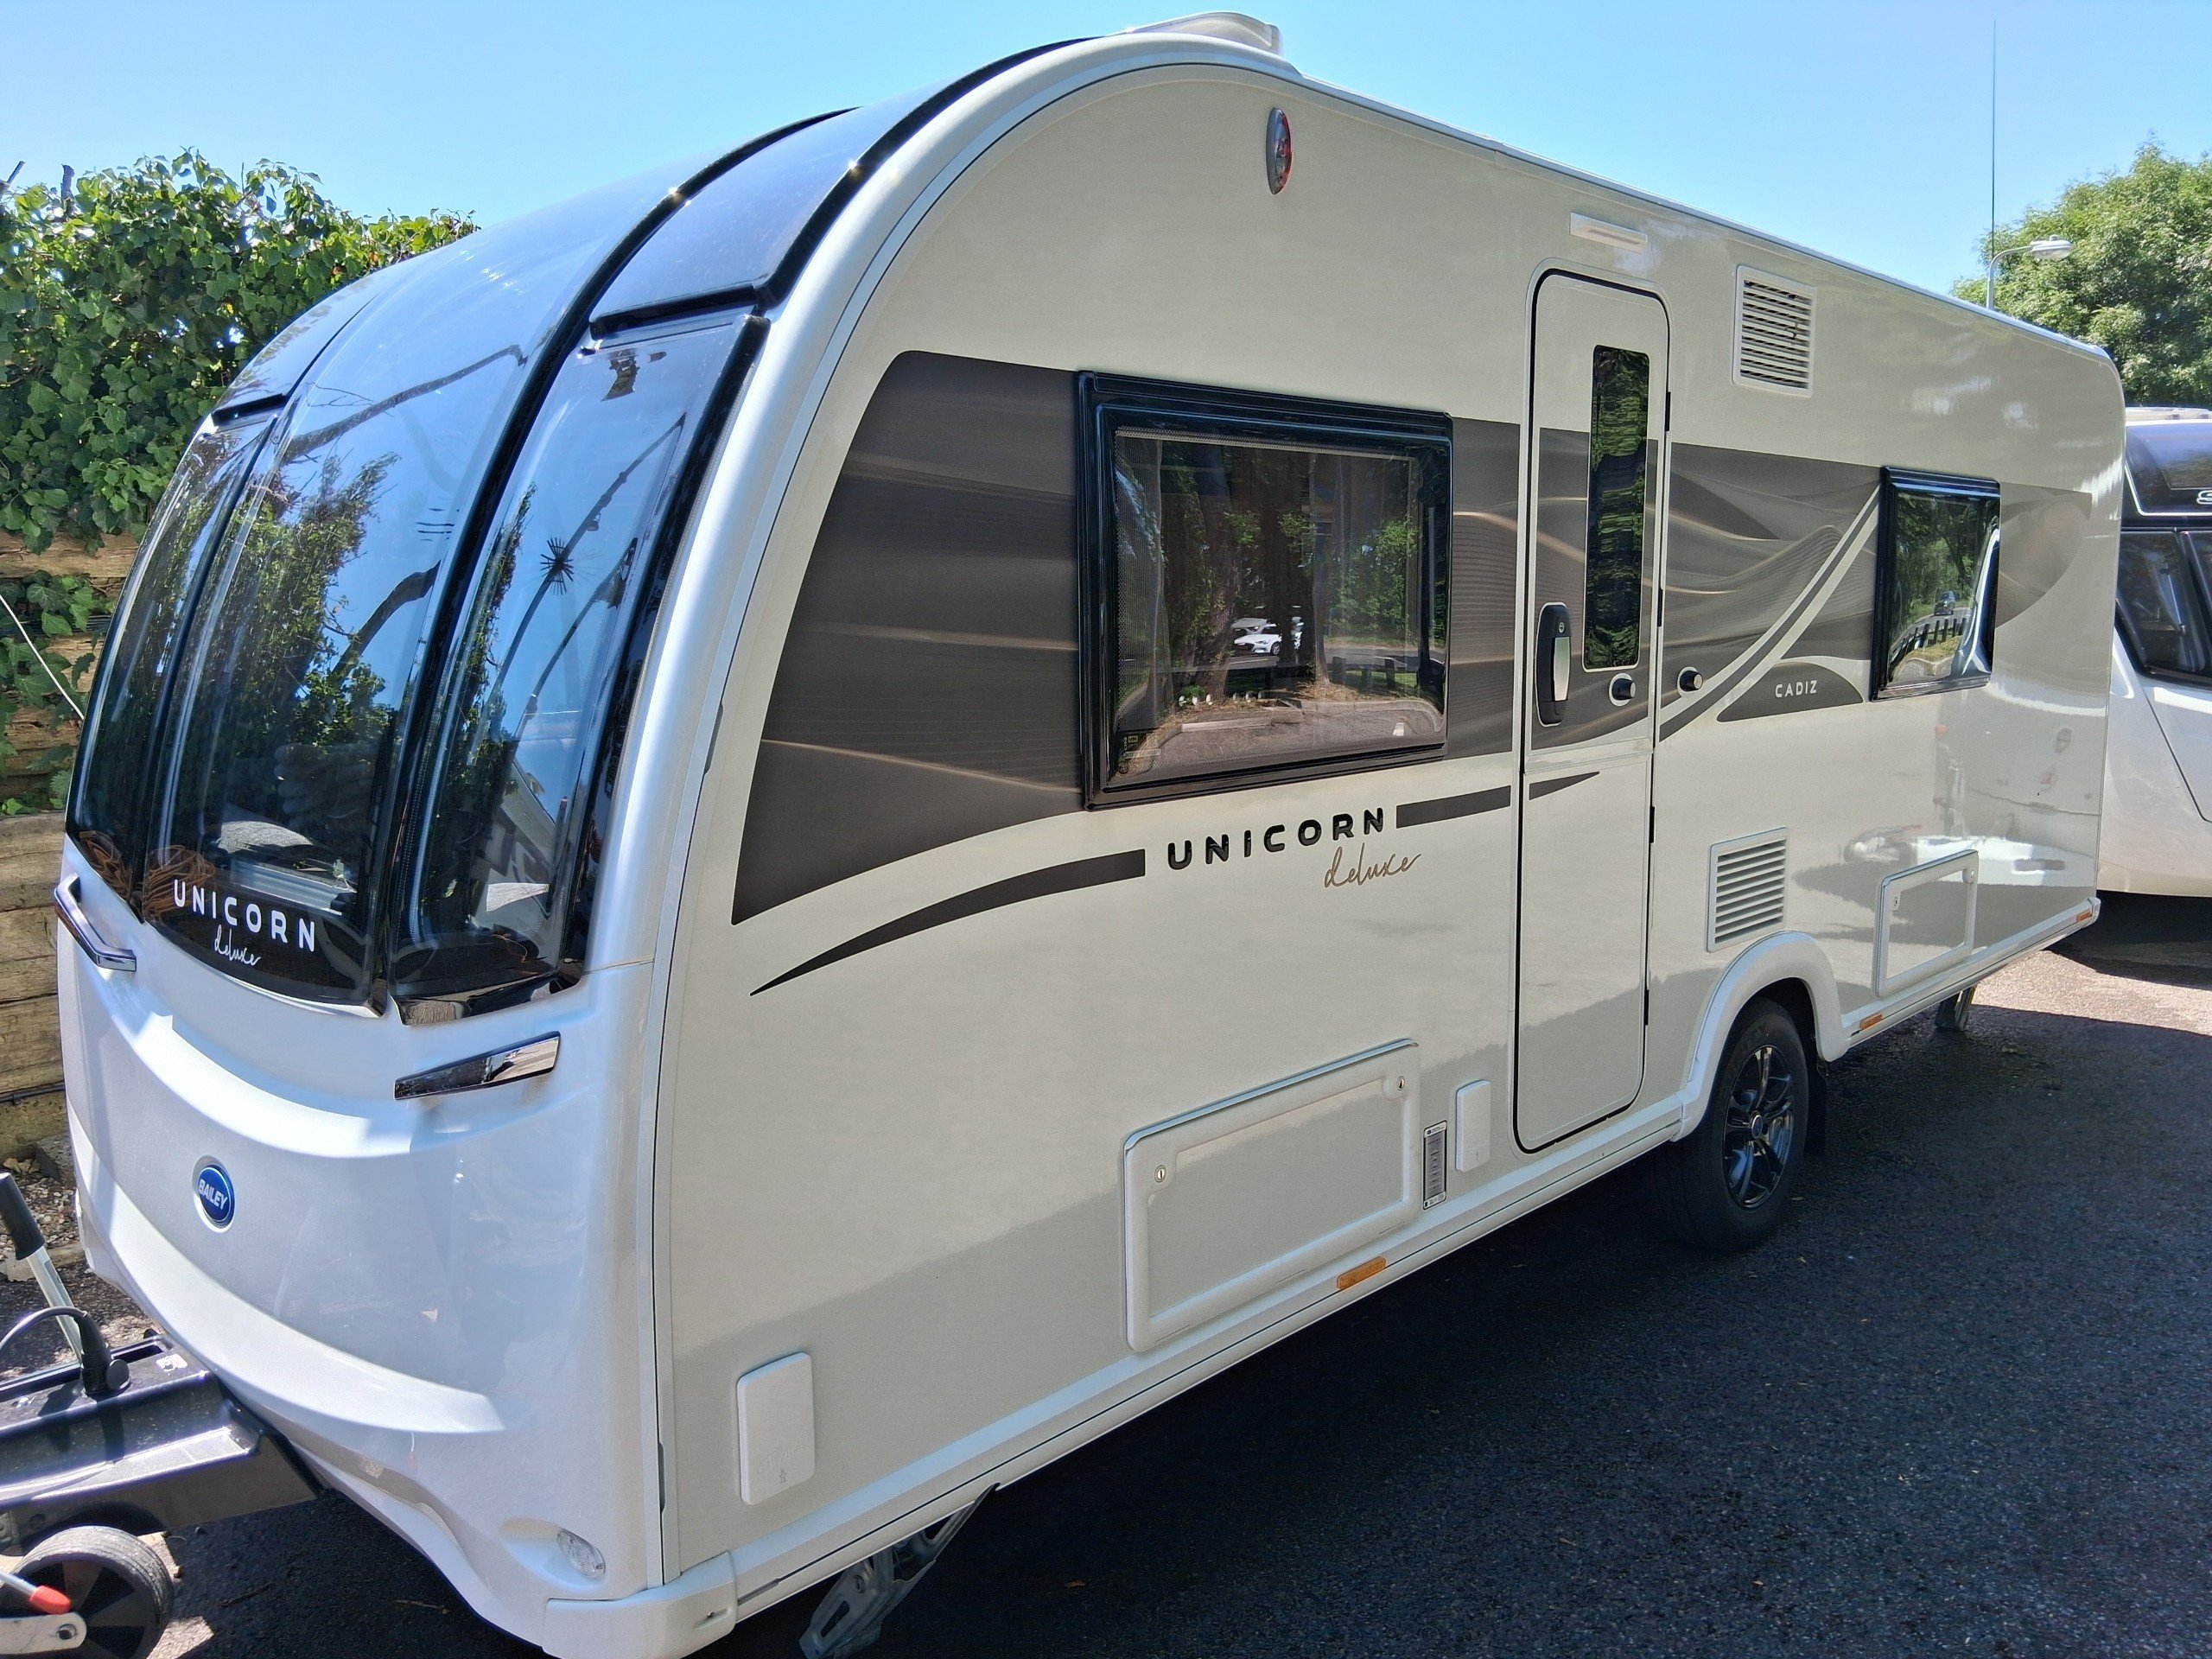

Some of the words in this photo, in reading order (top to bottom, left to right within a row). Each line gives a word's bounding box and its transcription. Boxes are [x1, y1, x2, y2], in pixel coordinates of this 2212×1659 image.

[1775, 679, 1817, 698] CADIZ
[1167, 807, 1384, 871] UNICORN
[1323, 842, 1422, 889] deluxe
[174, 879, 315, 952] UNICORN
[213, 924, 262, 966] deluxe
[198, 1179, 228, 1211] BAILEY
